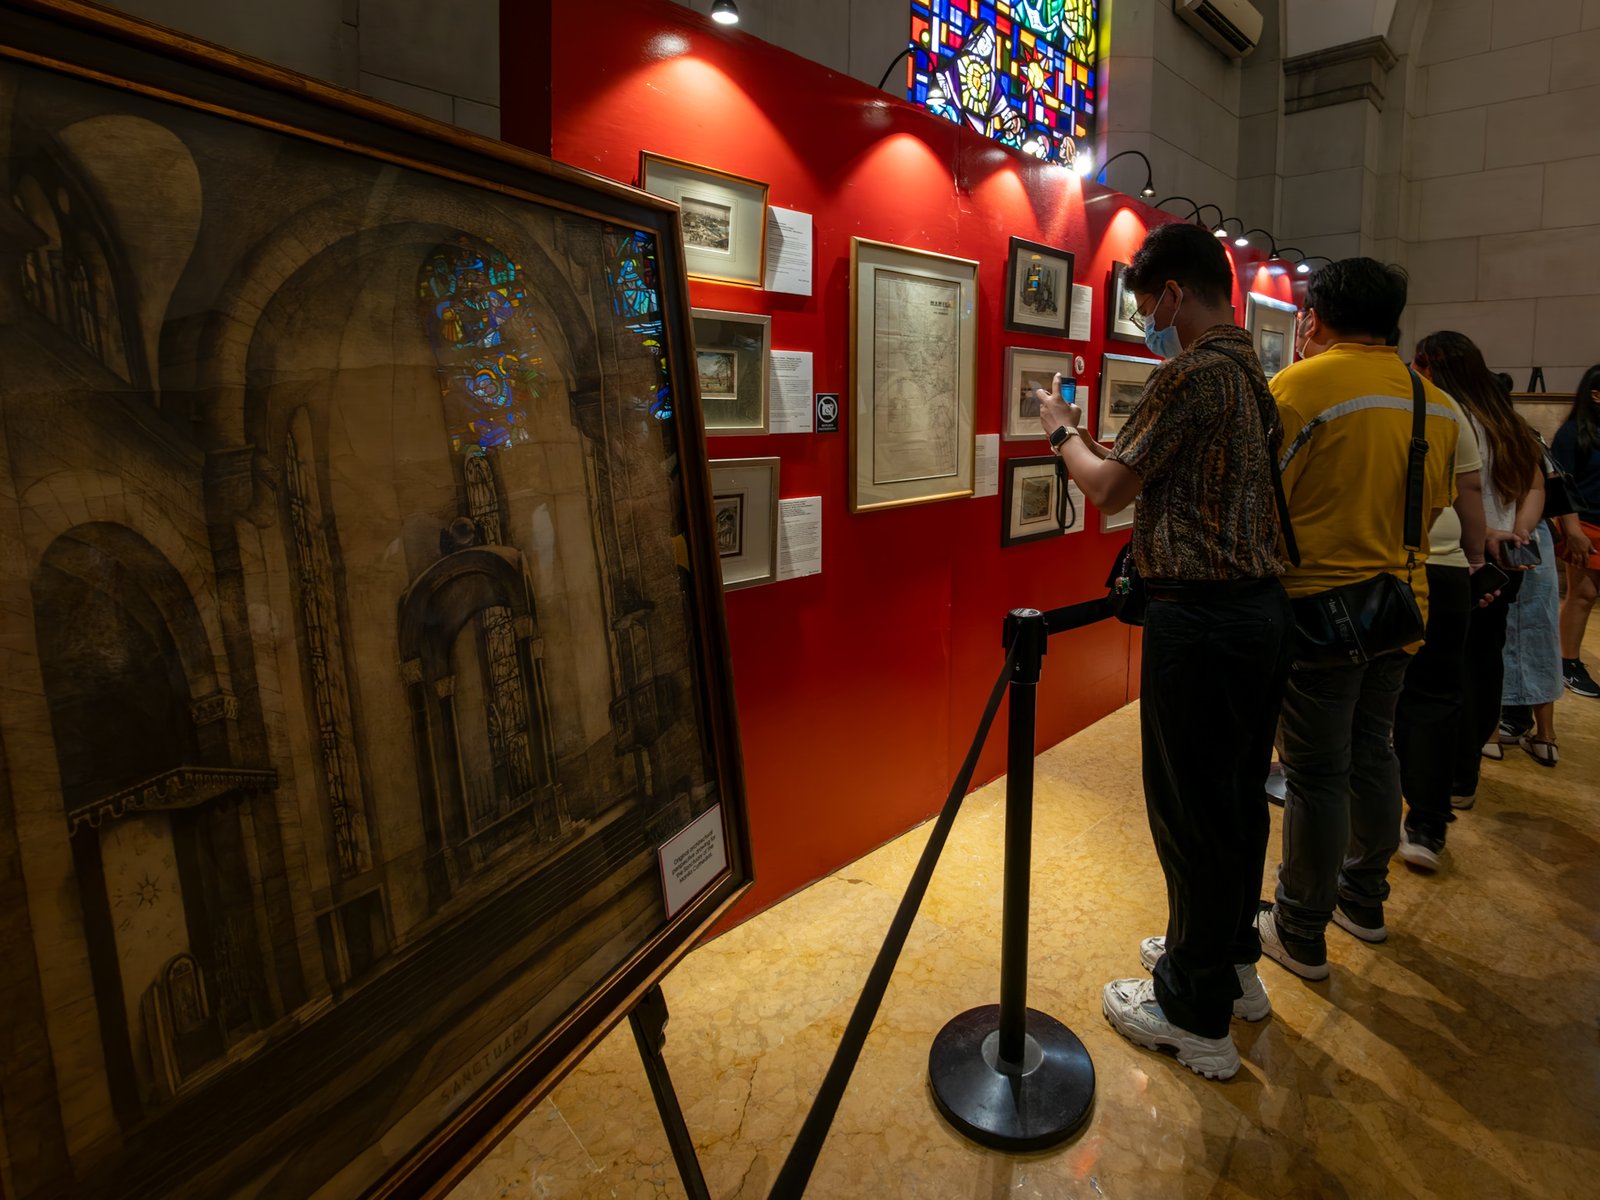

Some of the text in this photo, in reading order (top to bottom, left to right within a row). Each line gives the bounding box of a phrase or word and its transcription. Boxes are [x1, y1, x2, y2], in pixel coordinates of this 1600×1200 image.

[671, 852, 695, 876] perspective
[695, 840, 711, 855] drawing
[673, 829, 713, 865] Original architectural
[684, 853, 703, 872] Sanctuary
[679, 869, 693, 883] Manila
[440, 1019, 531, 1102] SANCTUARY
